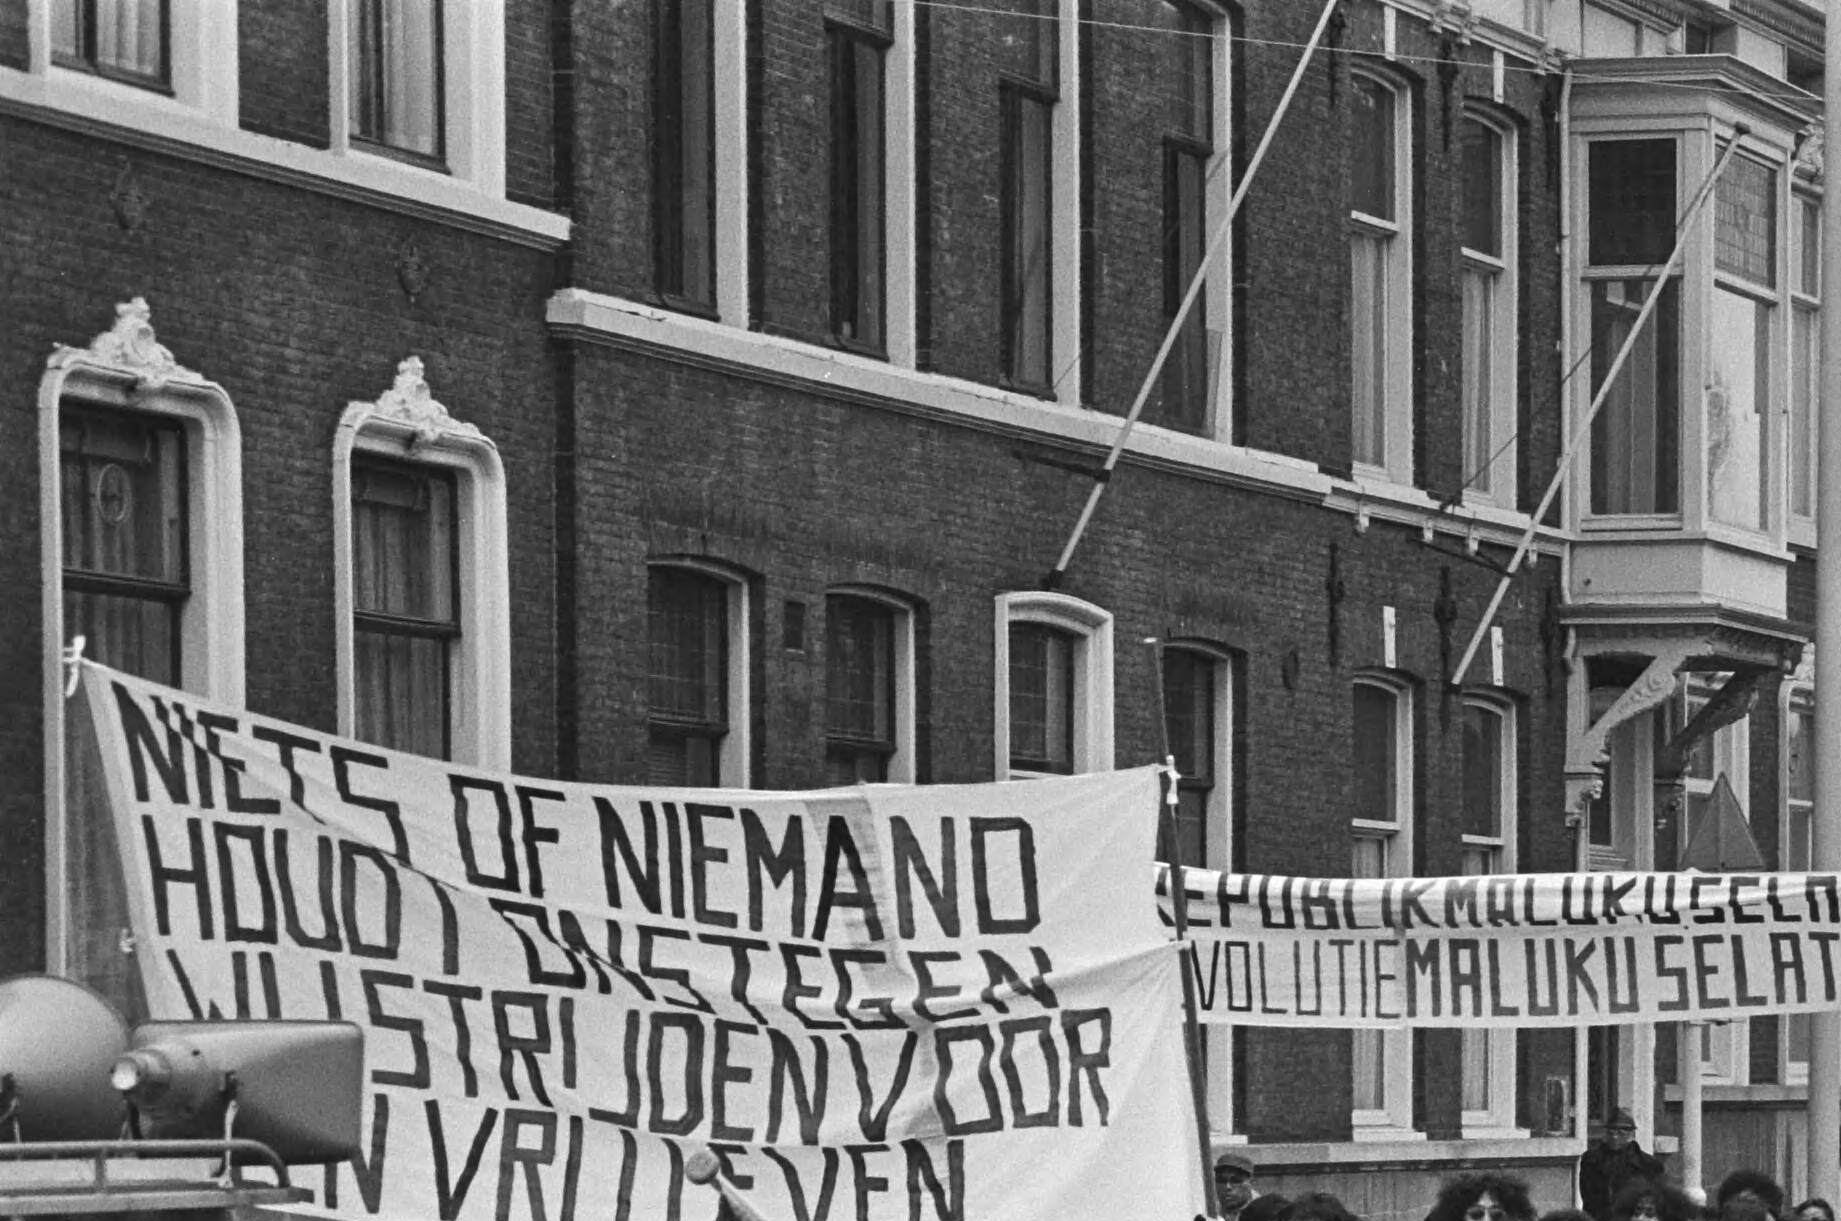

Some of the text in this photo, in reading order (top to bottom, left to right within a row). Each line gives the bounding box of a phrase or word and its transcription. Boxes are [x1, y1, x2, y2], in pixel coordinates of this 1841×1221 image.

[110, 679, 1041, 941] NIETS OF NIEMAND
